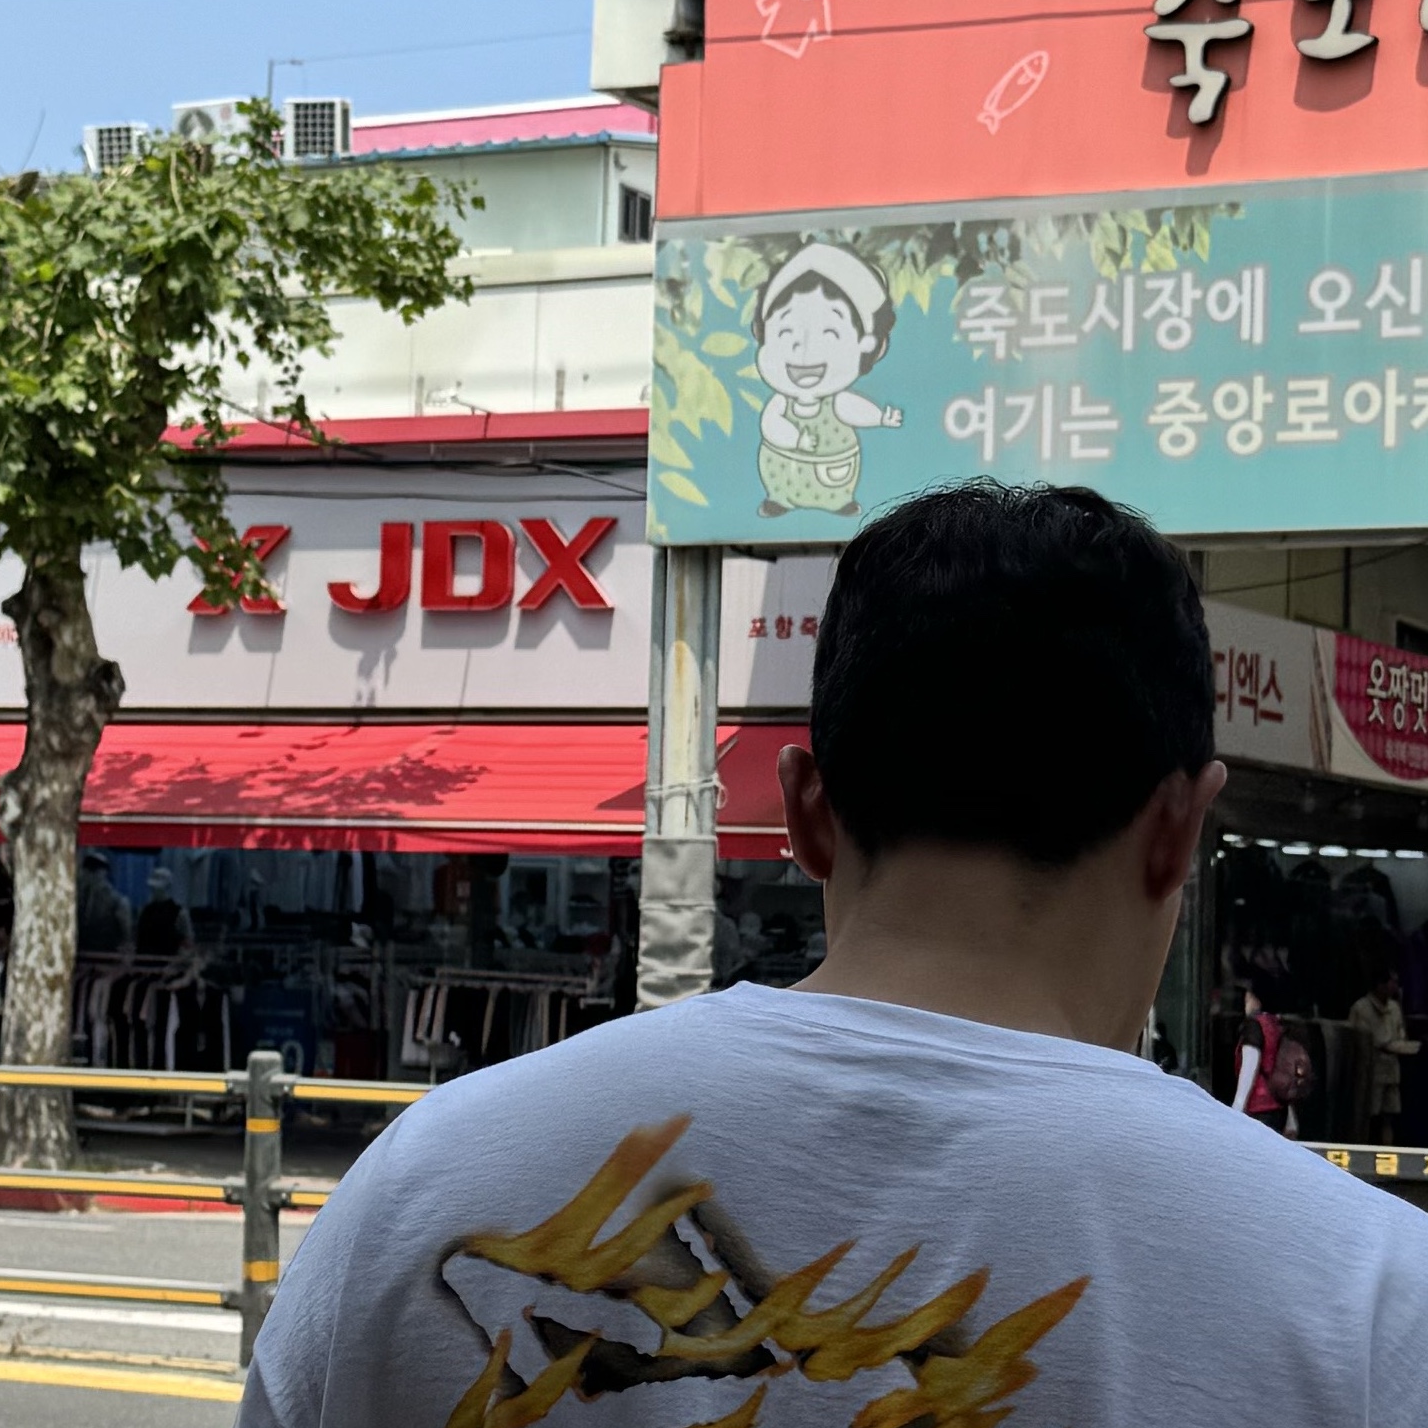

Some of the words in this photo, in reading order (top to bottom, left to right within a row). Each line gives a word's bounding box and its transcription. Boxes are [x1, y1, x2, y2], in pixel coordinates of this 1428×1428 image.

[959, 266, 1266, 360] 죽도시장에
[943, 382, 1120, 463] 여기는
[327, 517, 618, 613] JDX
